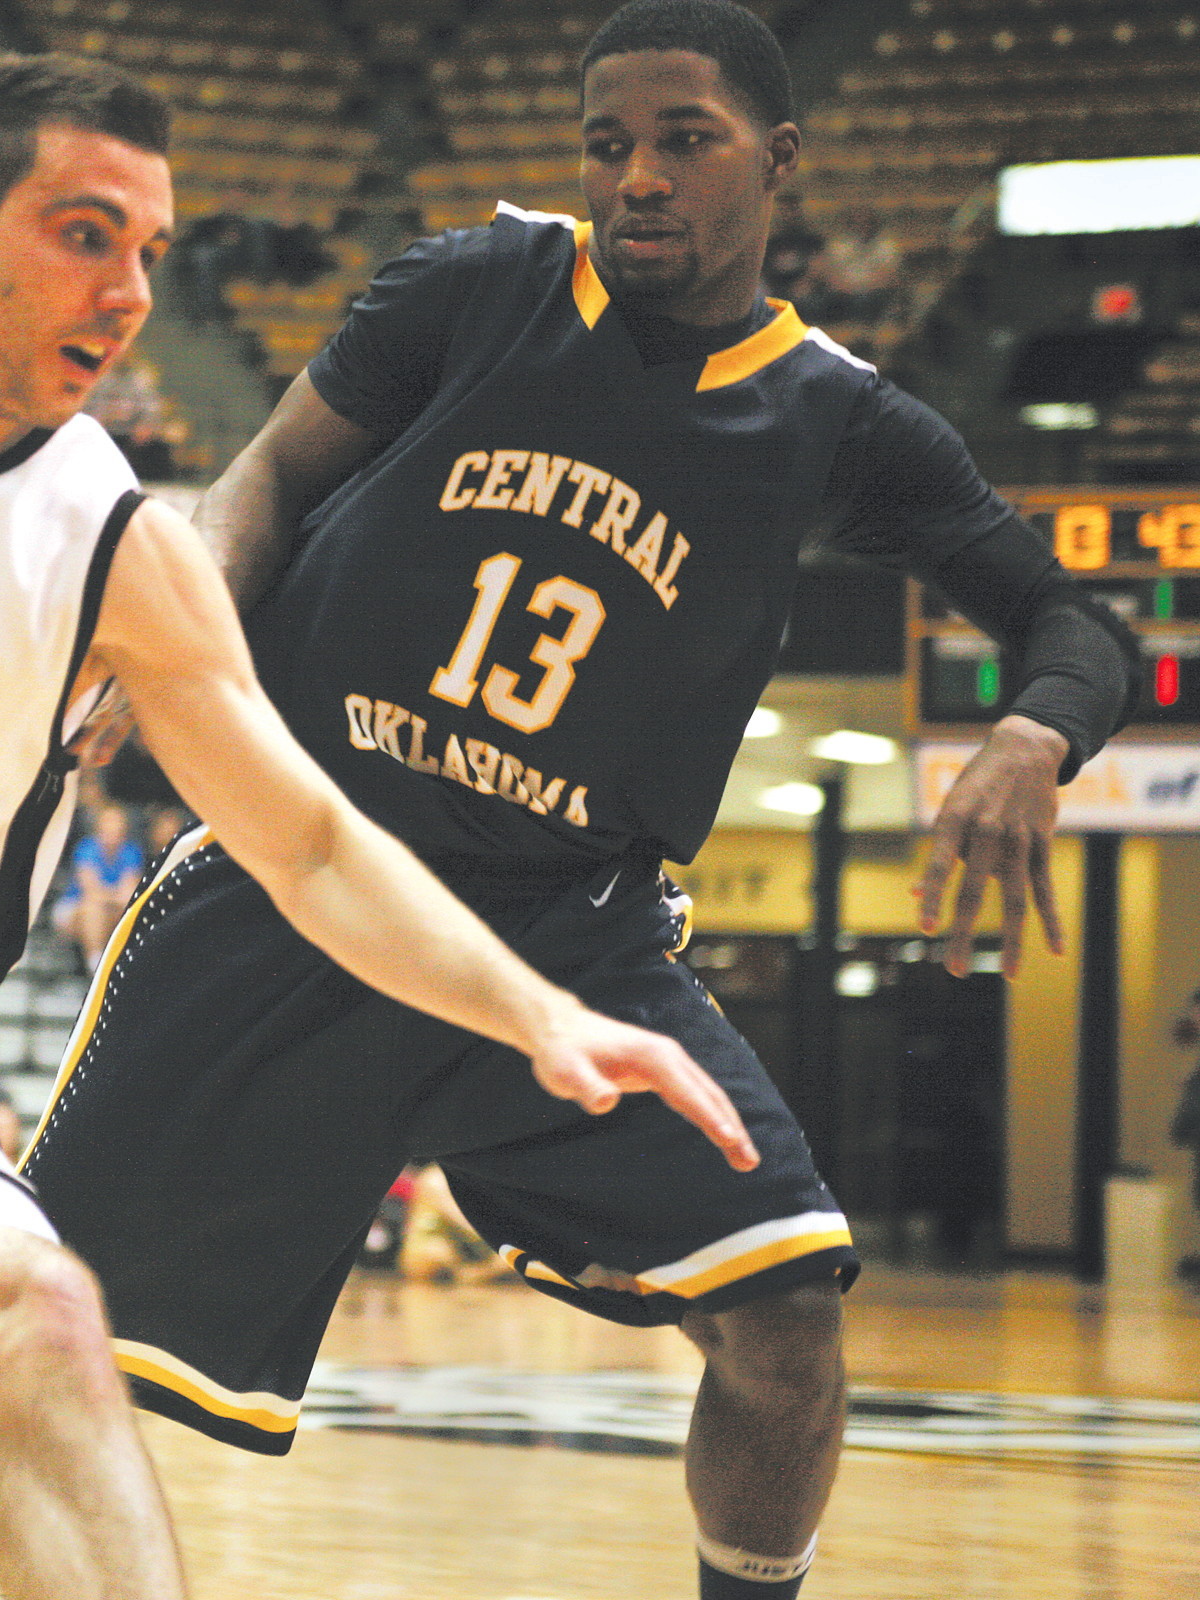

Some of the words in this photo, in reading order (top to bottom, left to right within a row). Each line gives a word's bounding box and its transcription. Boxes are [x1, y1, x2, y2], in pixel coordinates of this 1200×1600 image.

[438, 449, 691, 611] CENTRAL
[428, 551, 607, 735] 13
[344, 693, 589, 828] OKLAHOMA
